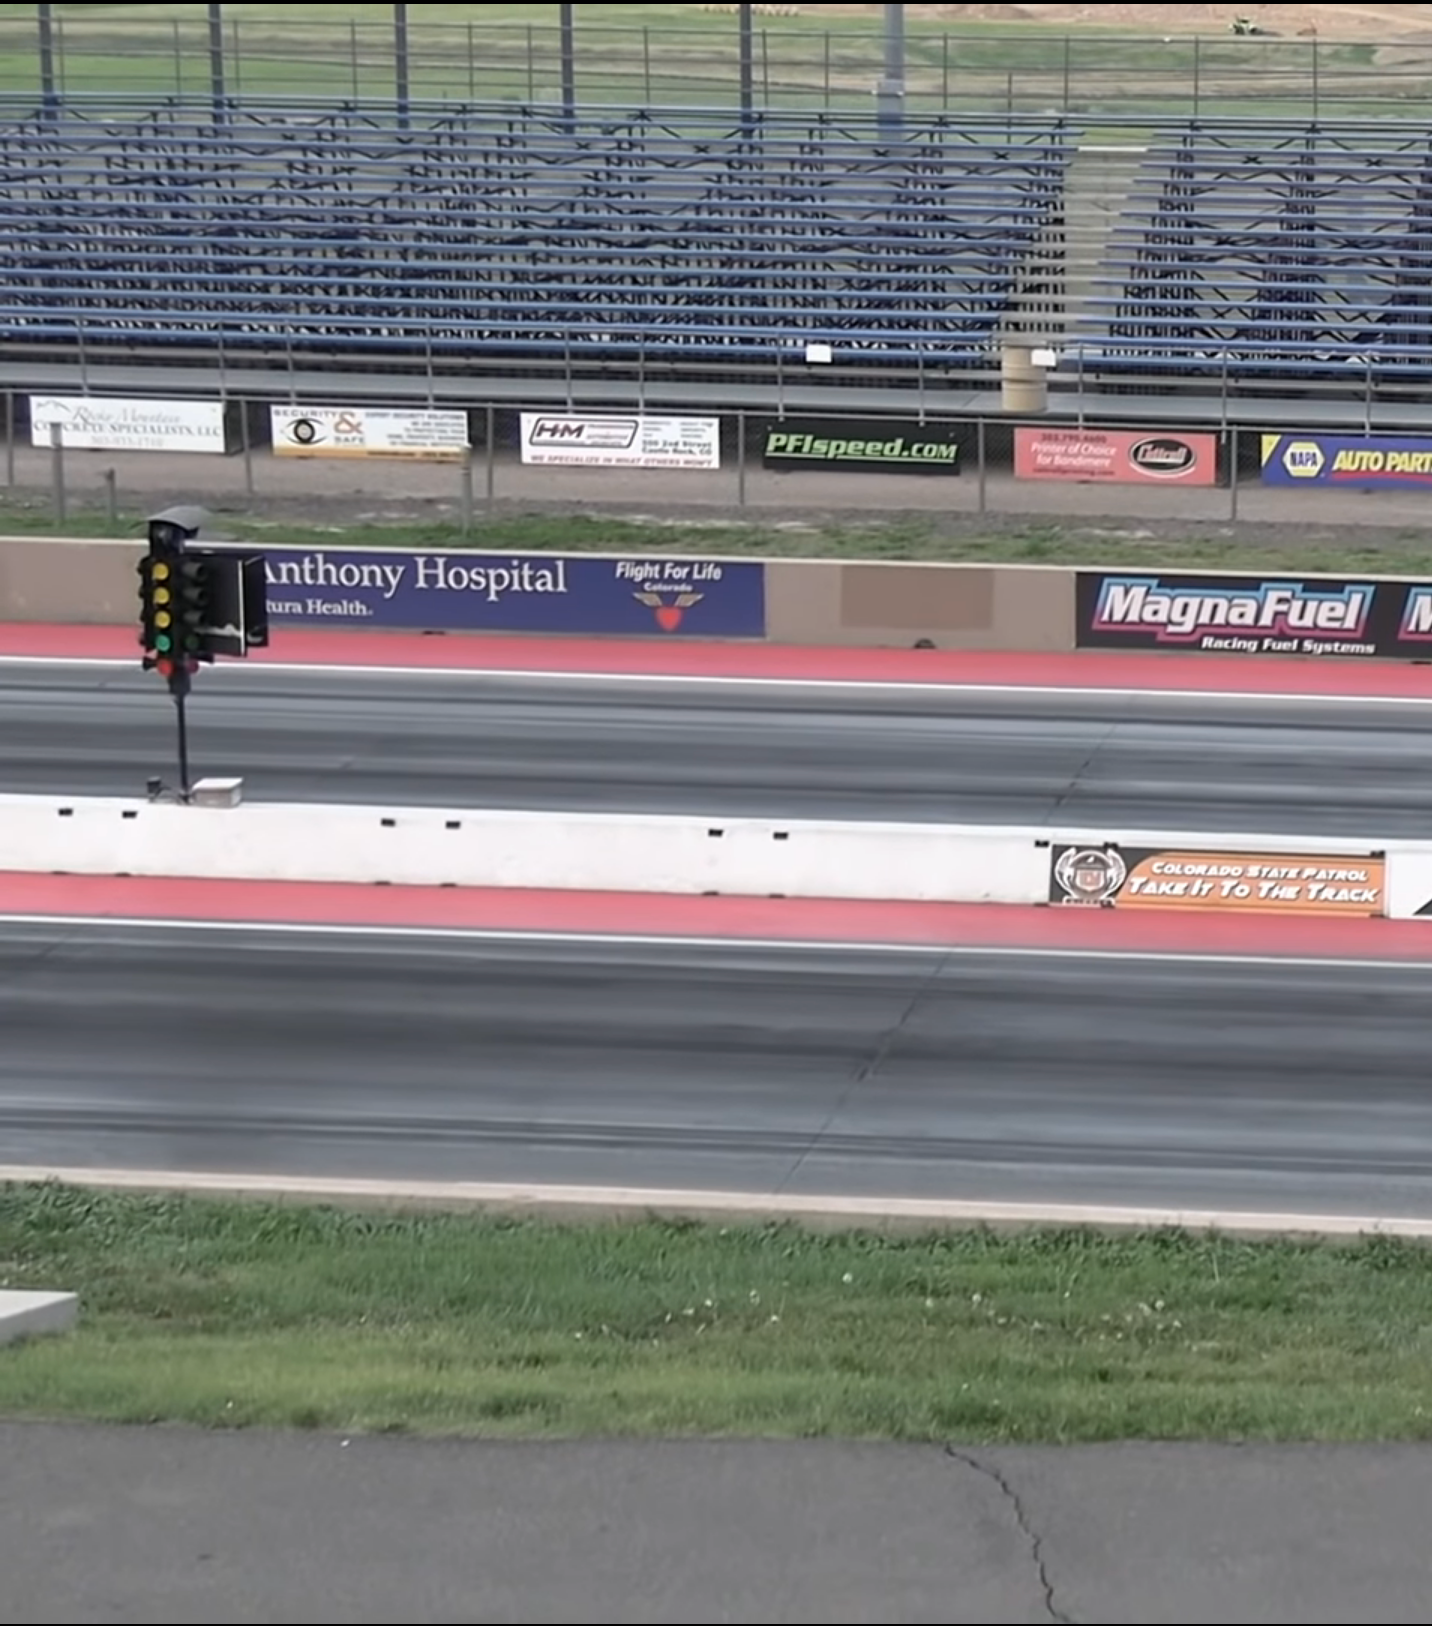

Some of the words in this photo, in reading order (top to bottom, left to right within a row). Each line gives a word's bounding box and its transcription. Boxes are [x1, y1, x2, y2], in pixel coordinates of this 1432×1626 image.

[274, 409, 338, 418] SECURITY
[34, 420, 103, 433] COCRETE
[334, 411, 364, 434] &
[335, 436, 365, 444] SAFE
[1031, 442, 1067, 454] Printer
[1067, 443, 1080, 454] of
[1081, 443, 1117, 457] Choice
[547, 455, 600, 464] SPECIALIZE
[615, 457, 641, 465] WHAT
[644, 458, 680, 466] OTHERS
[1036, 454, 1052, 465] for
[1289, 451, 1319, 468] NAPA
[1332, 449, 1383, 473] AUTO
[414, 556, 567, 601] Hospital
[615, 560, 660, 583] Flight
[663, 563, 690, 580] For
[692, 564, 722, 582] Life
[643, 582, 693, 593] Colorado
[266, 599, 303, 614] tura
[1100, 583, 1364, 634] MagnaFuel
[1202, 637, 1258, 655] Racing
[1262, 639, 1299, 652] Fuel
[1302, 640, 1376, 656] Systems
[1305, 884, 1379, 903] TRACK
